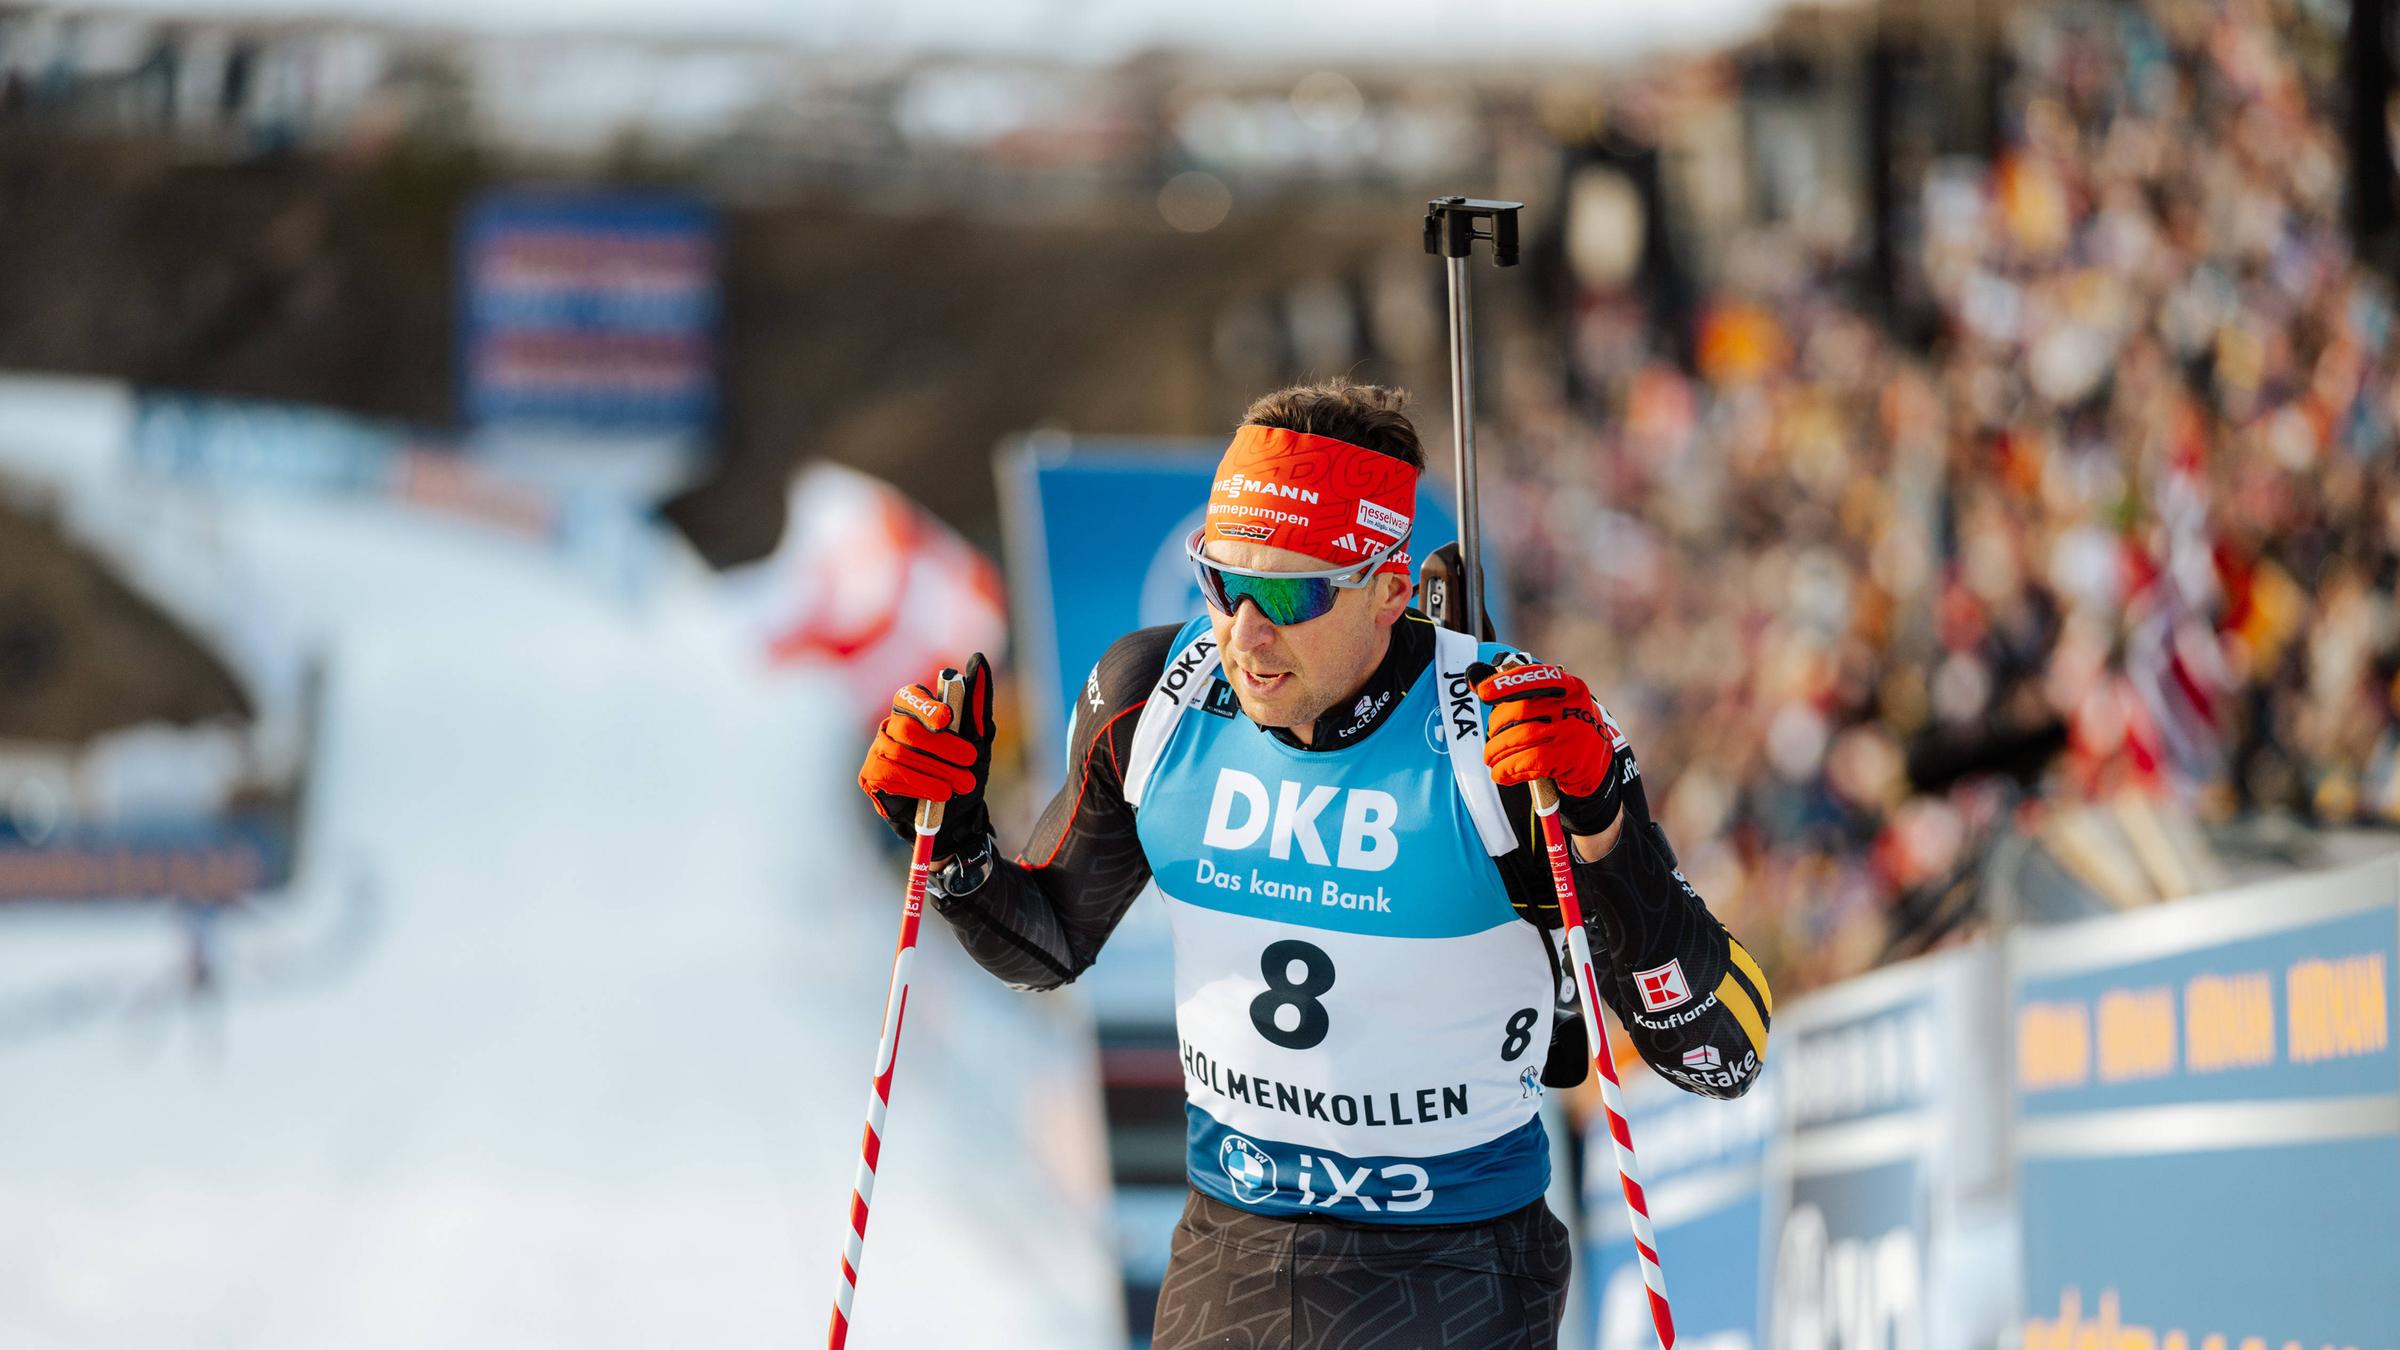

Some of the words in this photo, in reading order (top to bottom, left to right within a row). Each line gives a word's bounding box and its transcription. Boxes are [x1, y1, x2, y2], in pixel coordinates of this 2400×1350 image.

[1209, 502, 1310, 527] ärmepumpen
[1160, 641, 1218, 706] JOKA
[1338, 690, 1391, 738] tectake
[1443, 671, 1478, 741] JOKA
[1203, 767, 1399, 872] DKB
[1196, 858, 1242, 891] Das
[1250, 868, 1312, 904] kann
[1321, 880, 1392, 914] Bank
[1249, 939, 1336, 1050] 8
[1632, 991, 1718, 1030] Kaufland
[1501, 1007, 1538, 1062] 8
[1182, 1038, 1469, 1127] HOLMENKOLLEN
[1223, 1139, 1269, 1165] BMW
[1299, 1153, 1435, 1213] iX3
